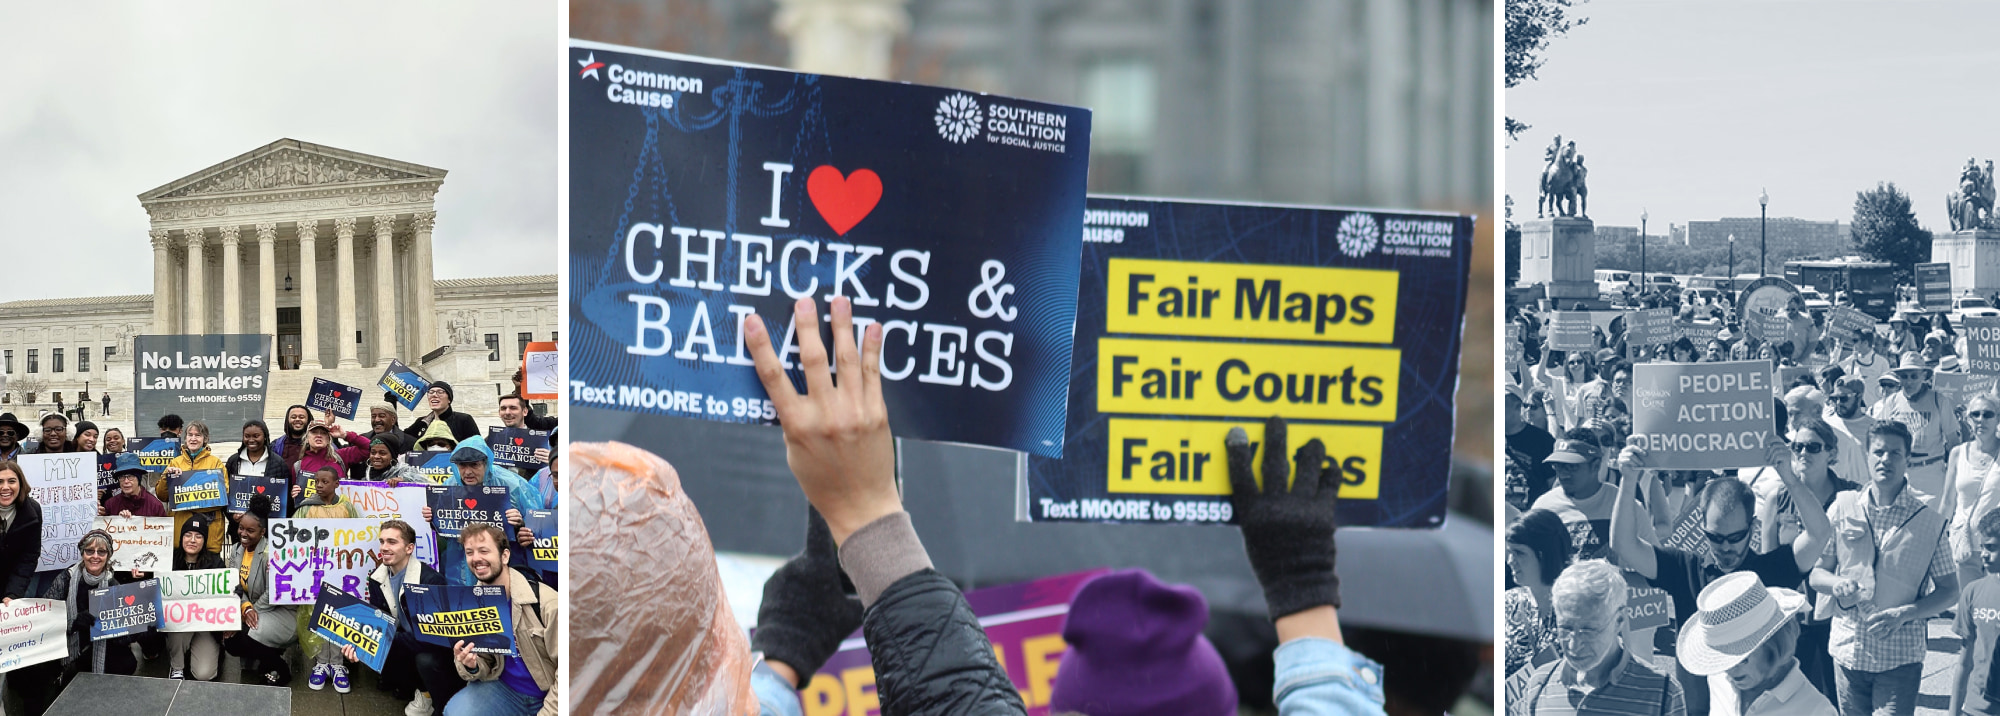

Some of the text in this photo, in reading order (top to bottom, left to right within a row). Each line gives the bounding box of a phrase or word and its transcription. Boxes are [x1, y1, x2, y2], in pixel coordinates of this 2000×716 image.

[607, 64, 703, 94] Common
[607, 84, 674, 109] Cause
[988, 104, 1067, 129] SOUTHERN
[987, 118, 1066, 143] COALITION
[987, 134, 1066, 154] for SOCIAL JUSTICE
[760, 161, 794, 228] I
[1084, 209, 1149, 227] ommon
[1384, 219, 1453, 234] SOUTHERN
[1083, 227, 1124, 243] ause
[1383, 233, 1452, 247] COALITION
[1422, 248, 1451, 257] JUSTICE
[625, 222, 1018, 322] CHECKS &
[1128, 273, 1375, 335] Fair Maps
[142, 351, 262, 369] No Lawless
[1971, 359, 1991, 370] FOR
[141, 372, 262, 390] Lawmakers
[389, 371, 419, 394] Hands Off
[1112, 354, 1384, 406] Fair Courts
[1679, 371, 1769, 393] PEOPLE.
[315, 393, 345, 406] CHECKS
[394, 385, 414, 402] VOTE
[570, 380, 616, 404] Text
[619, 385, 703, 414] MOORE
[706, 395, 729, 416] to
[313, 400, 352, 415] BALANCES
[1677, 401, 1770, 422] ACTION.
[493, 444, 530, 454] CHECKS
[44, 458, 80, 481] MY
[1121, 437, 1210, 482] Fair
[30, 483, 93, 505] FUTURE
[174, 482, 219, 493] Hands Off
[175, 490, 219, 503] MY VOTE
[42, 501, 98, 523] EPENDS
[457, 499, 463, 509] I
[1040, 498, 1233, 521] Text MOORE to 95559
[144, 518, 164, 530] been
[437, 509, 503, 521] CHECKS &
[65, 522, 88, 538] MY
[272, 520, 329, 556] Stop
[534, 538, 552, 548] NO
[41, 543, 79, 566] VOT
[270, 546, 334, 574] with
[180, 570, 230, 596] JUSTICE
[99, 602, 155, 621] CHECKS &
[118, 597, 124, 607] I
[101, 612, 157, 631] BALANCES
[187, 603, 236, 624] Peace
[323, 604, 361, 630] Hands
[362, 624, 382, 642] Off
[417, 609, 497, 624] NO LAWLESS
[320, 616, 340, 632] MY
[344, 628, 377, 654] VOTE
[422, 621, 501, 635] LAWMAKERS
